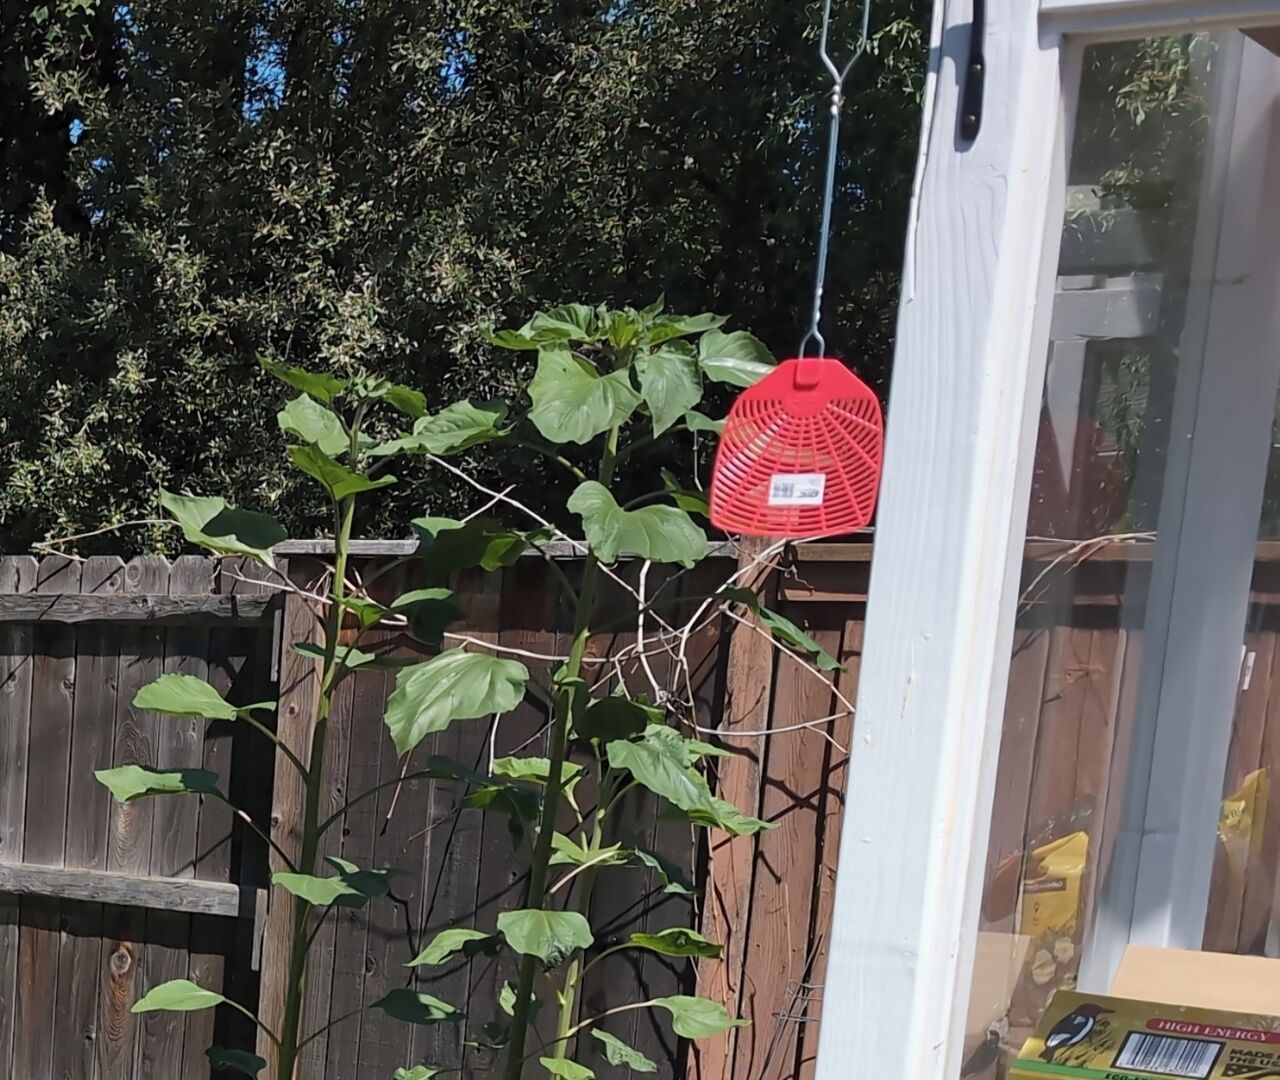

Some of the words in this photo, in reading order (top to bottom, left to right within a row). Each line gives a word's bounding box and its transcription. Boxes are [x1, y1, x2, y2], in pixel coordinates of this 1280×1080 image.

[1157, 1020, 1199, 1034] HIGH
[1204, 1025, 1271, 1041] ENERGY
[1230, 1048, 1274, 1060] MADE
